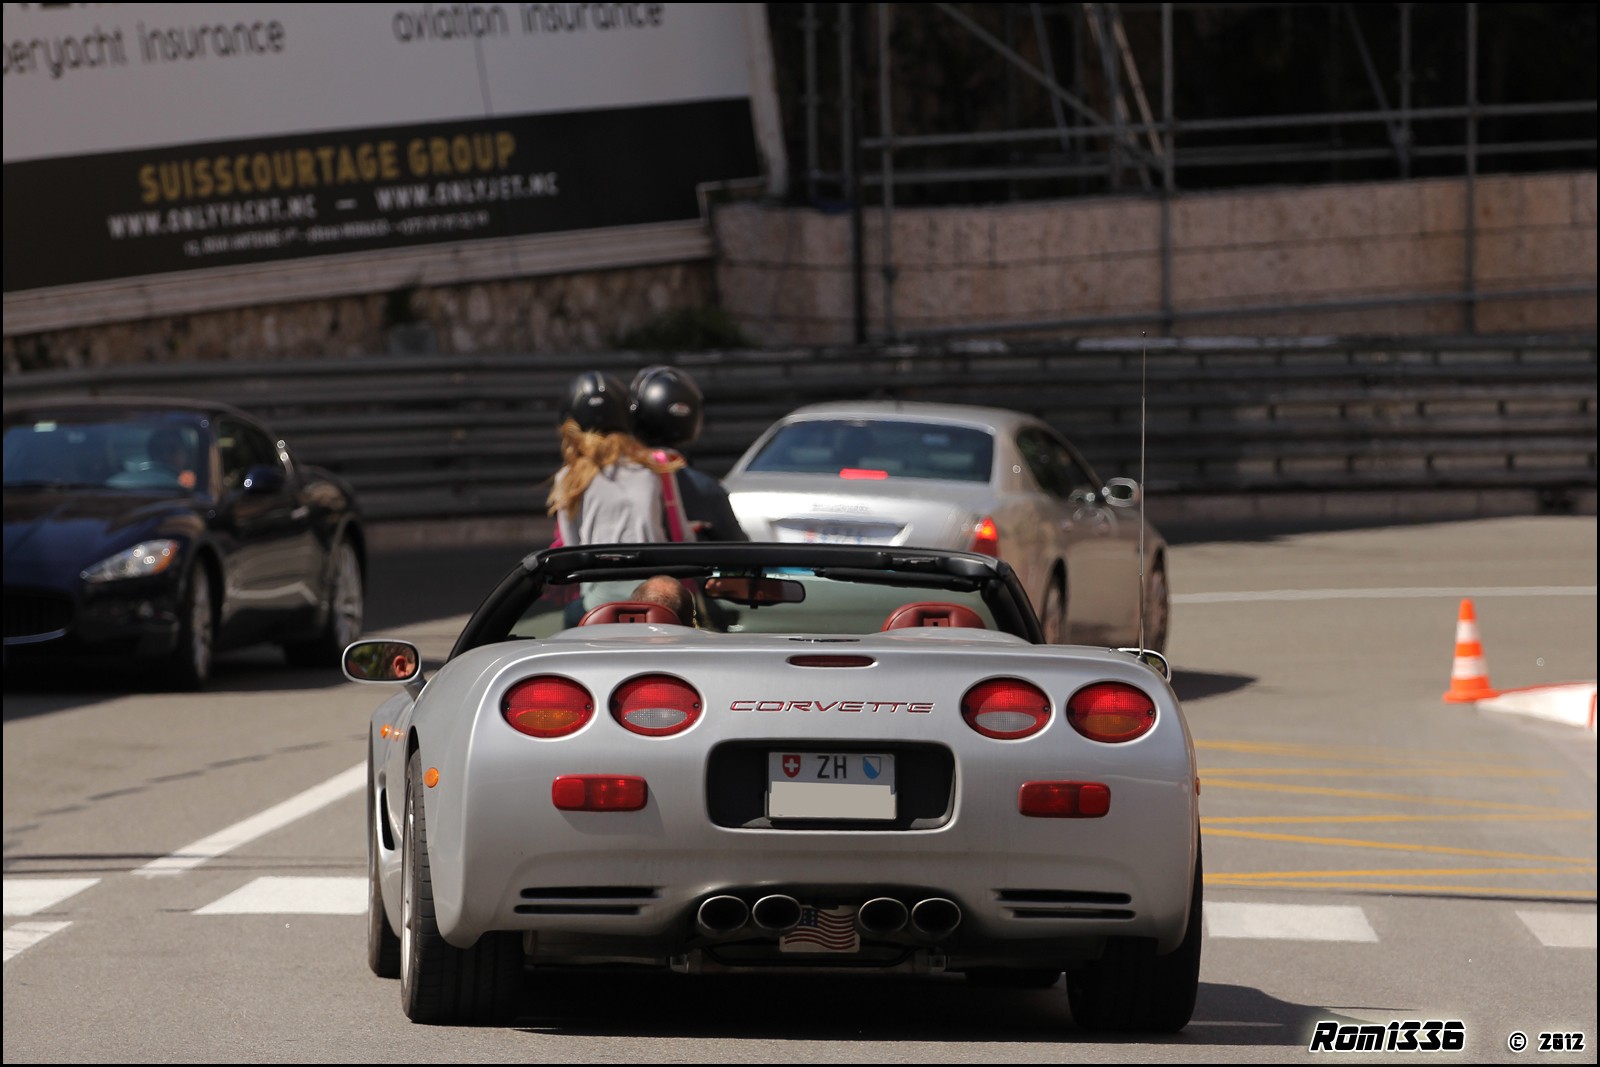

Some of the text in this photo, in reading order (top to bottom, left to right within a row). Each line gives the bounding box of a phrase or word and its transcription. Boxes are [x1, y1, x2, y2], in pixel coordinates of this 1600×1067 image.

[137, 18, 286, 64] insurance
[392, 3, 664, 43] aviation insurance
[139, 131, 516, 203] SUISSCOURTAGE GROUP
[730, 700, 935, 713] CORVETTE
[816, 755, 847, 779] ZH
